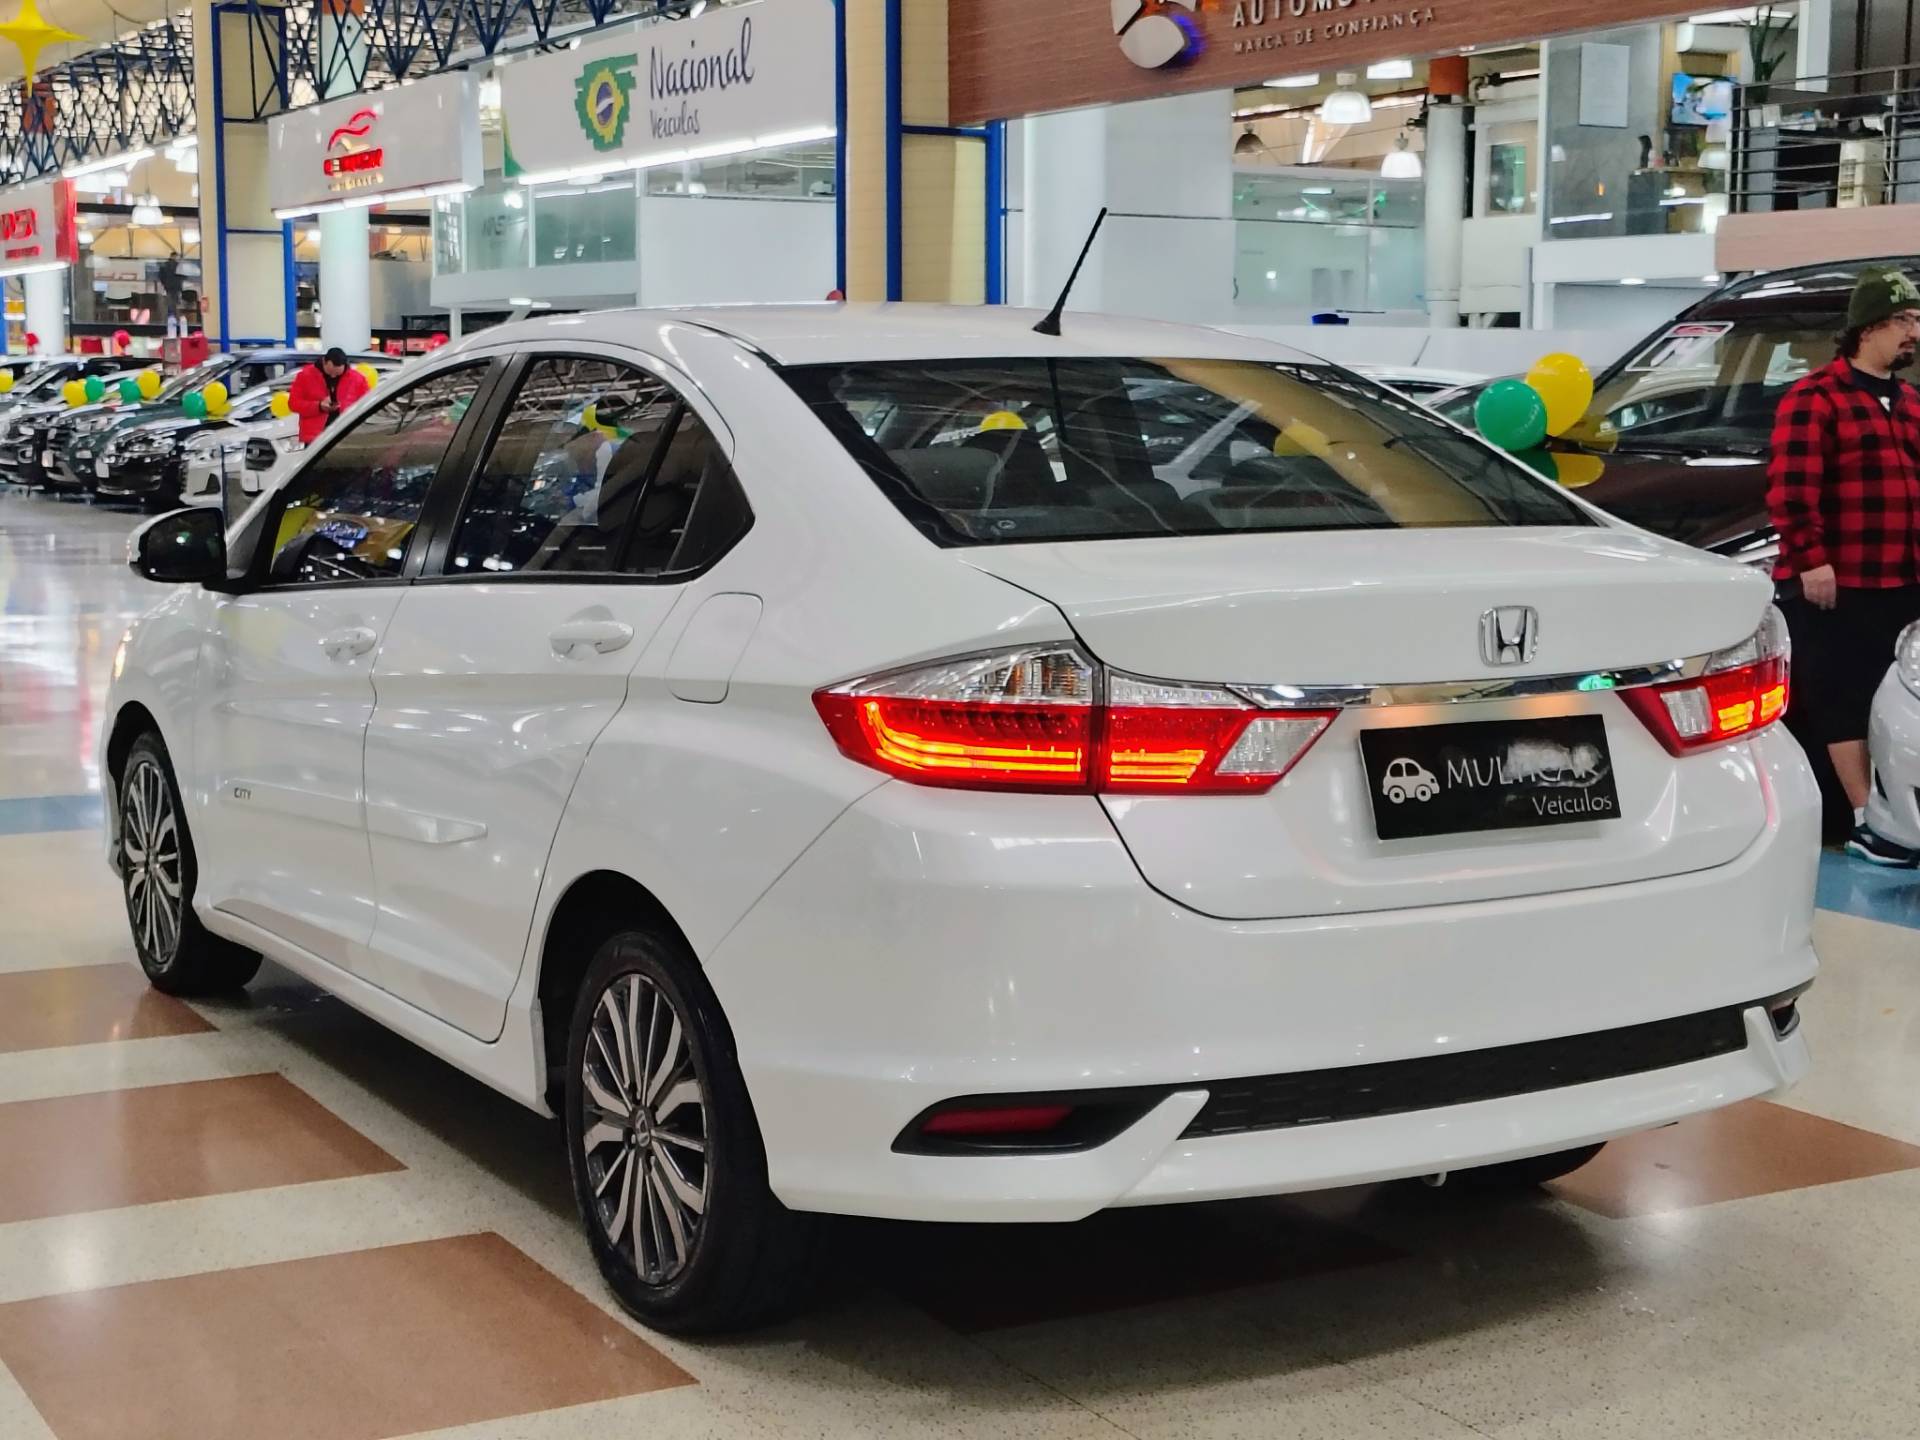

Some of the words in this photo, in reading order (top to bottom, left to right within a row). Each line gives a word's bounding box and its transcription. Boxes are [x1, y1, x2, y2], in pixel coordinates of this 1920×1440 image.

[1233, 34, 1284, 54] MARCA
[1295, 28, 1313, 45] DE
[1323, 8, 1434, 39] CONFIANÇA
[649, 16, 755, 100] Nacional
[1532, 787, 1613, 816] Veiculos
